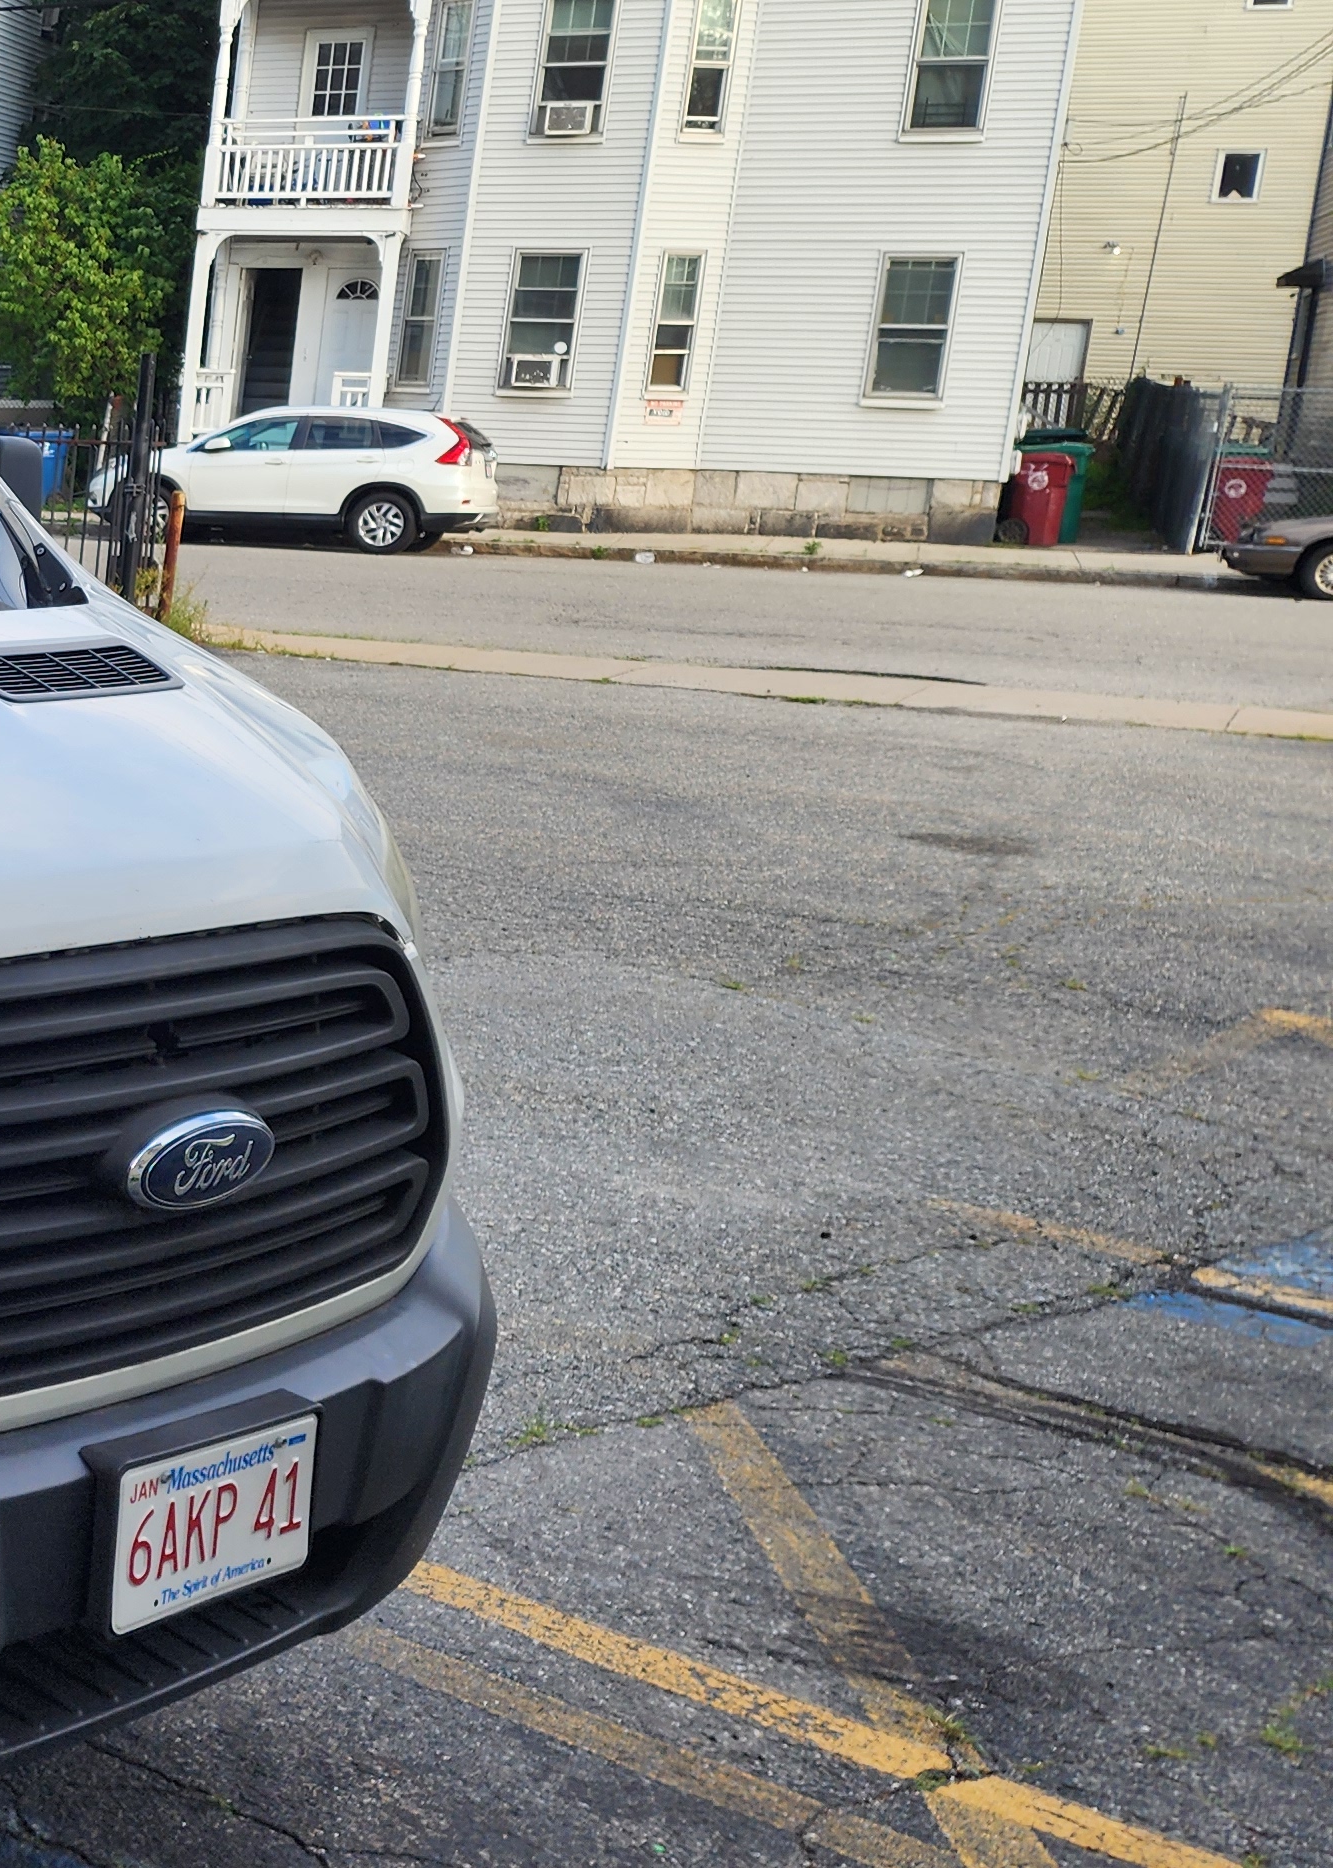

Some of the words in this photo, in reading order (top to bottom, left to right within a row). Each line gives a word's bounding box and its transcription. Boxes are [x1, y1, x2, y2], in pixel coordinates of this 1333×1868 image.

[174, 1133, 254, 1196] Ford
[129, 1477, 160, 1504] JAN
[166, 1443, 275, 1494] Massachusetts
[128, 1480, 238, 1586] 6AKP
[252, 1460, 302, 1540] 41
[161, 1587, 180, 1605] The
[182, 1576, 208, 1598] Spirit
[210, 1567, 223, 1587] of
[222, 1557, 265, 1582] America
